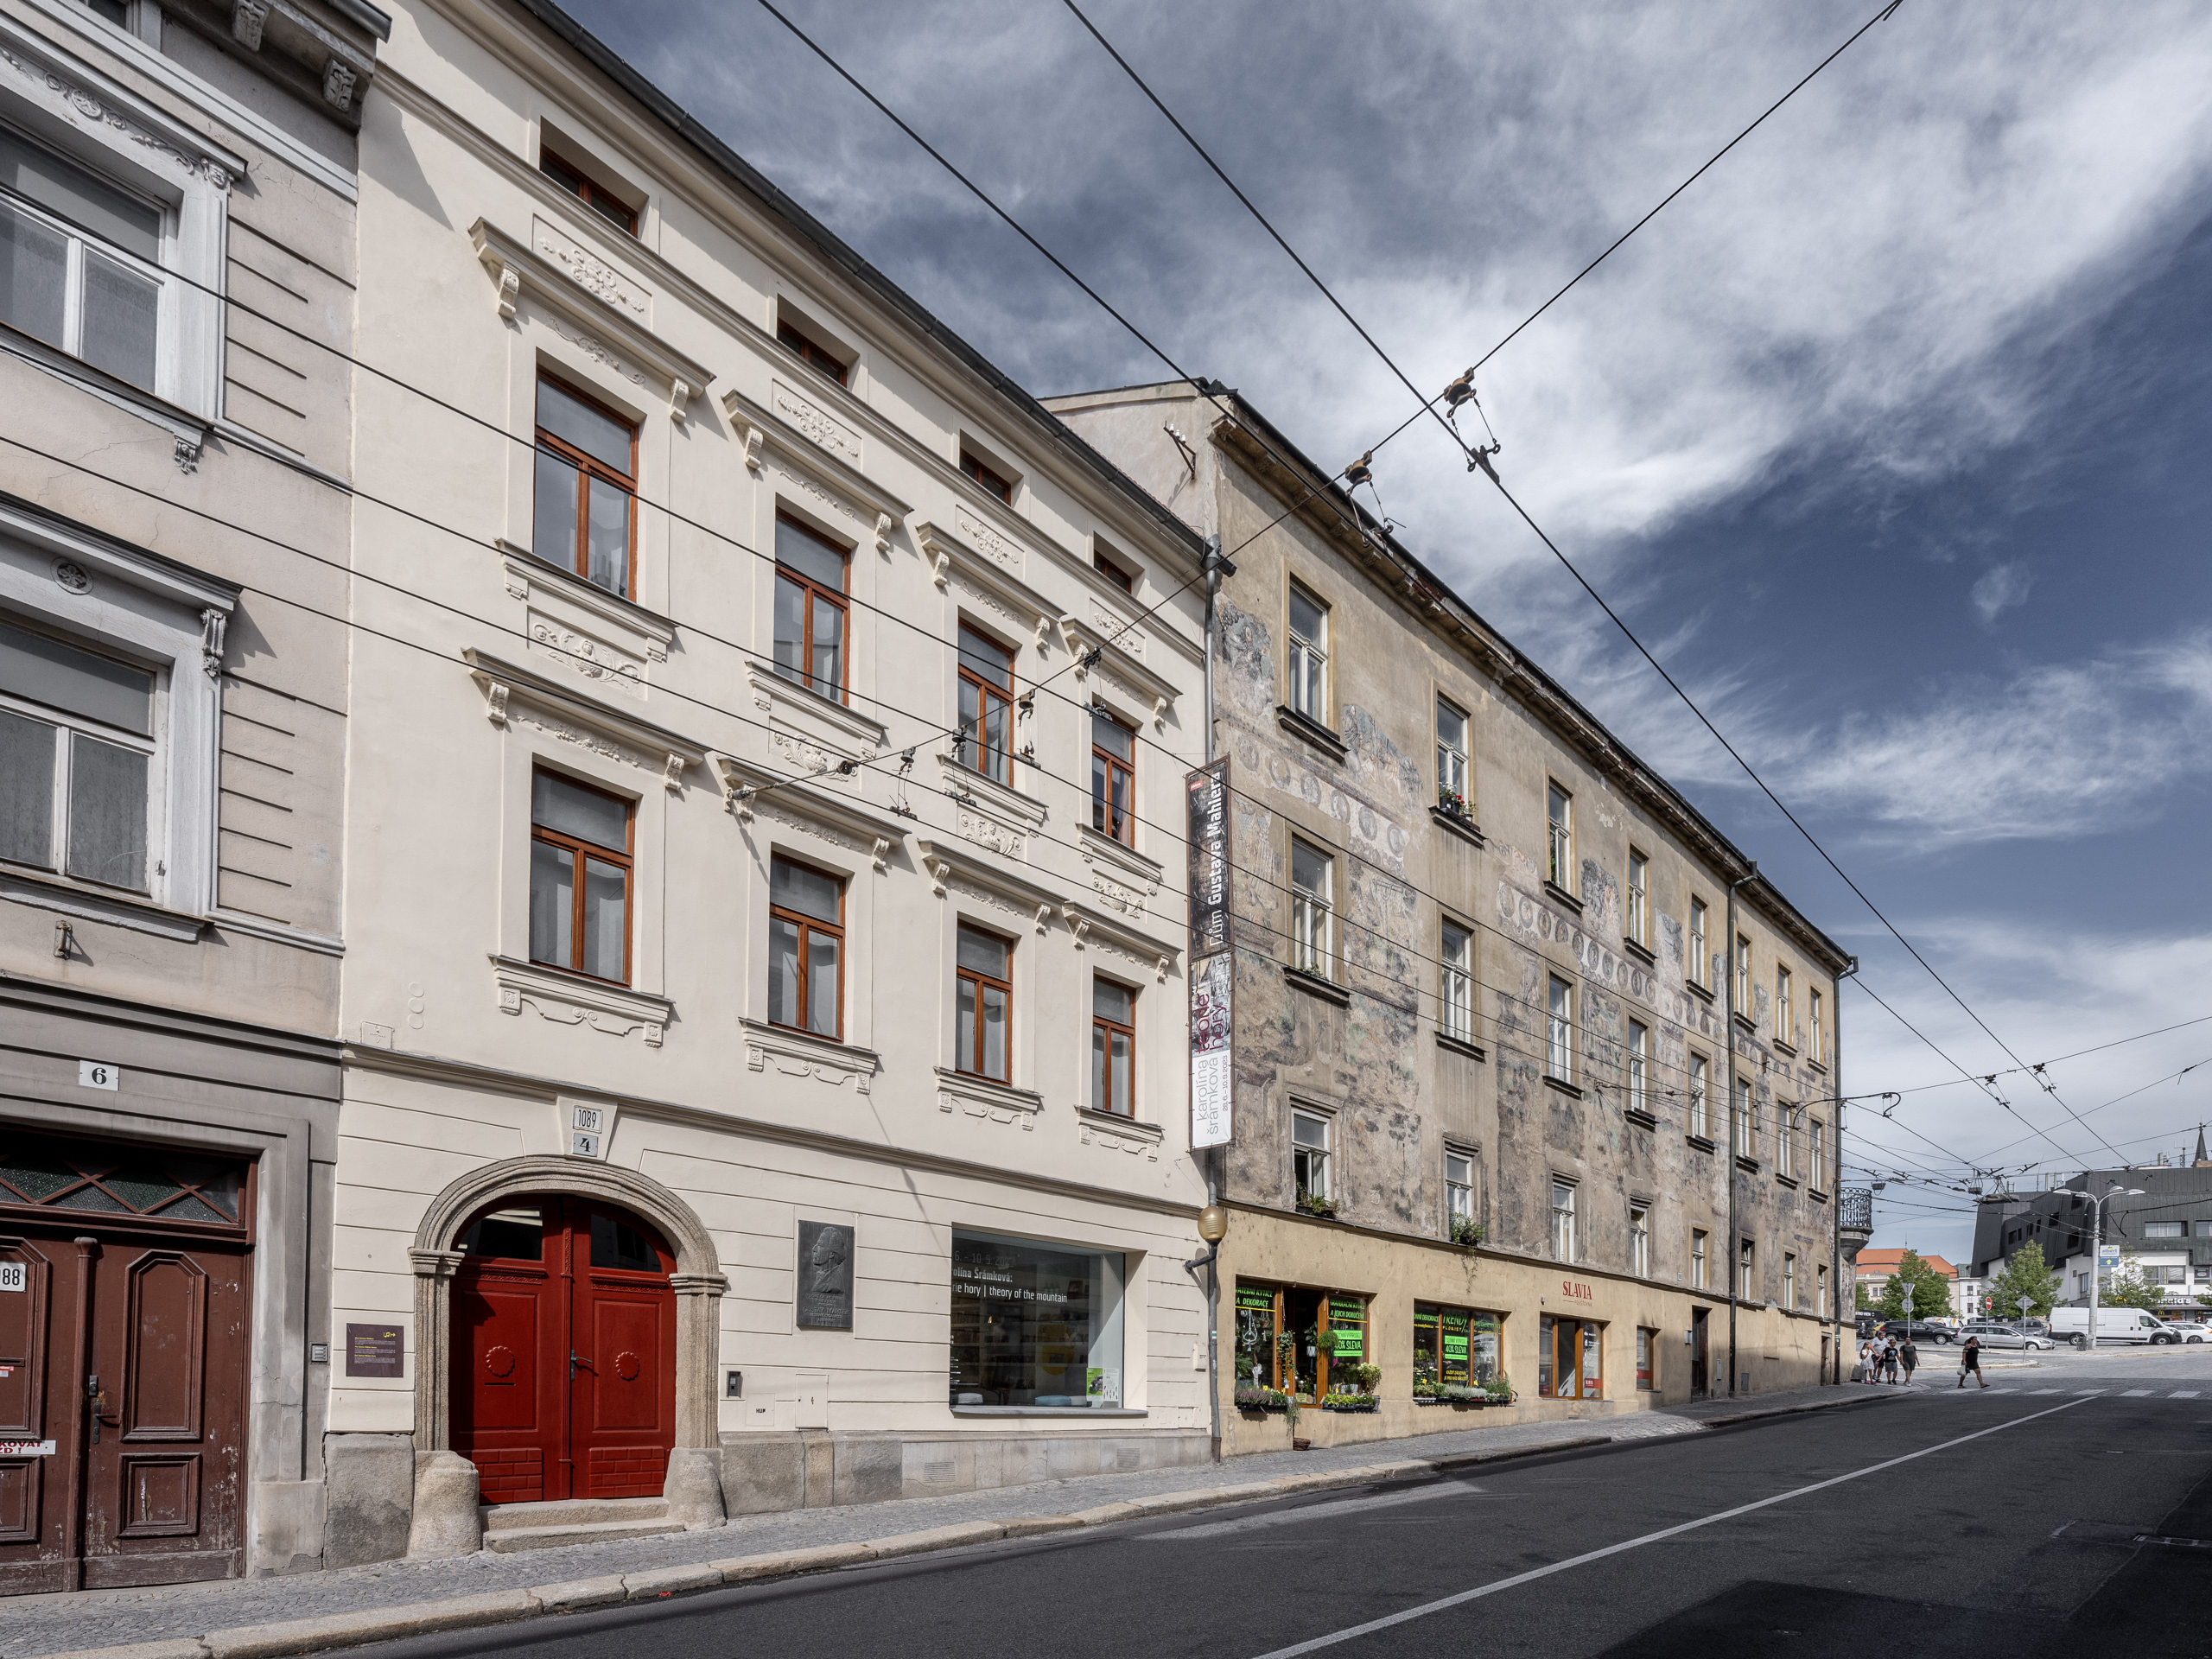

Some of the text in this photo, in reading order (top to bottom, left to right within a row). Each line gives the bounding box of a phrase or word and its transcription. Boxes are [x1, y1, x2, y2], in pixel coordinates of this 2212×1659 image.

[1207, 772, 1223, 946] Dům Gustava Mahlera
[1197, 993, 1210, 1054] teorie
[1210, 1004, 1227, 1050] hory
[92, 1067, 107, 1084] 6
[1197, 1059, 1209, 1121] karolína
[1206, 1057, 1218, 1135] šrámková
[578, 1109, 597, 1128] 1089
[580, 1138, 590, 1152] 4
[0, 1268, 20, 1286] 88
[952, 1267, 1013, 1282] olína Šrámková:
[964, 1283, 981, 1297] hory
[989, 1287, 1012, 1300] theory
[1014, 1289, 1021, 1298] of
[1024, 1289, 1034, 1300] the
[1037, 1293, 1067, 1303] mountain
[1563, 1281, 1592, 1300] SLAVIA
[1243, 1298, 1268, 1307] DEKORACE
[1443, 1313, 1468, 1332] TRENDY
[1346, 1340, 1362, 1350] SLEVA
[1454, 1345, 1466, 1354] SLEVA
